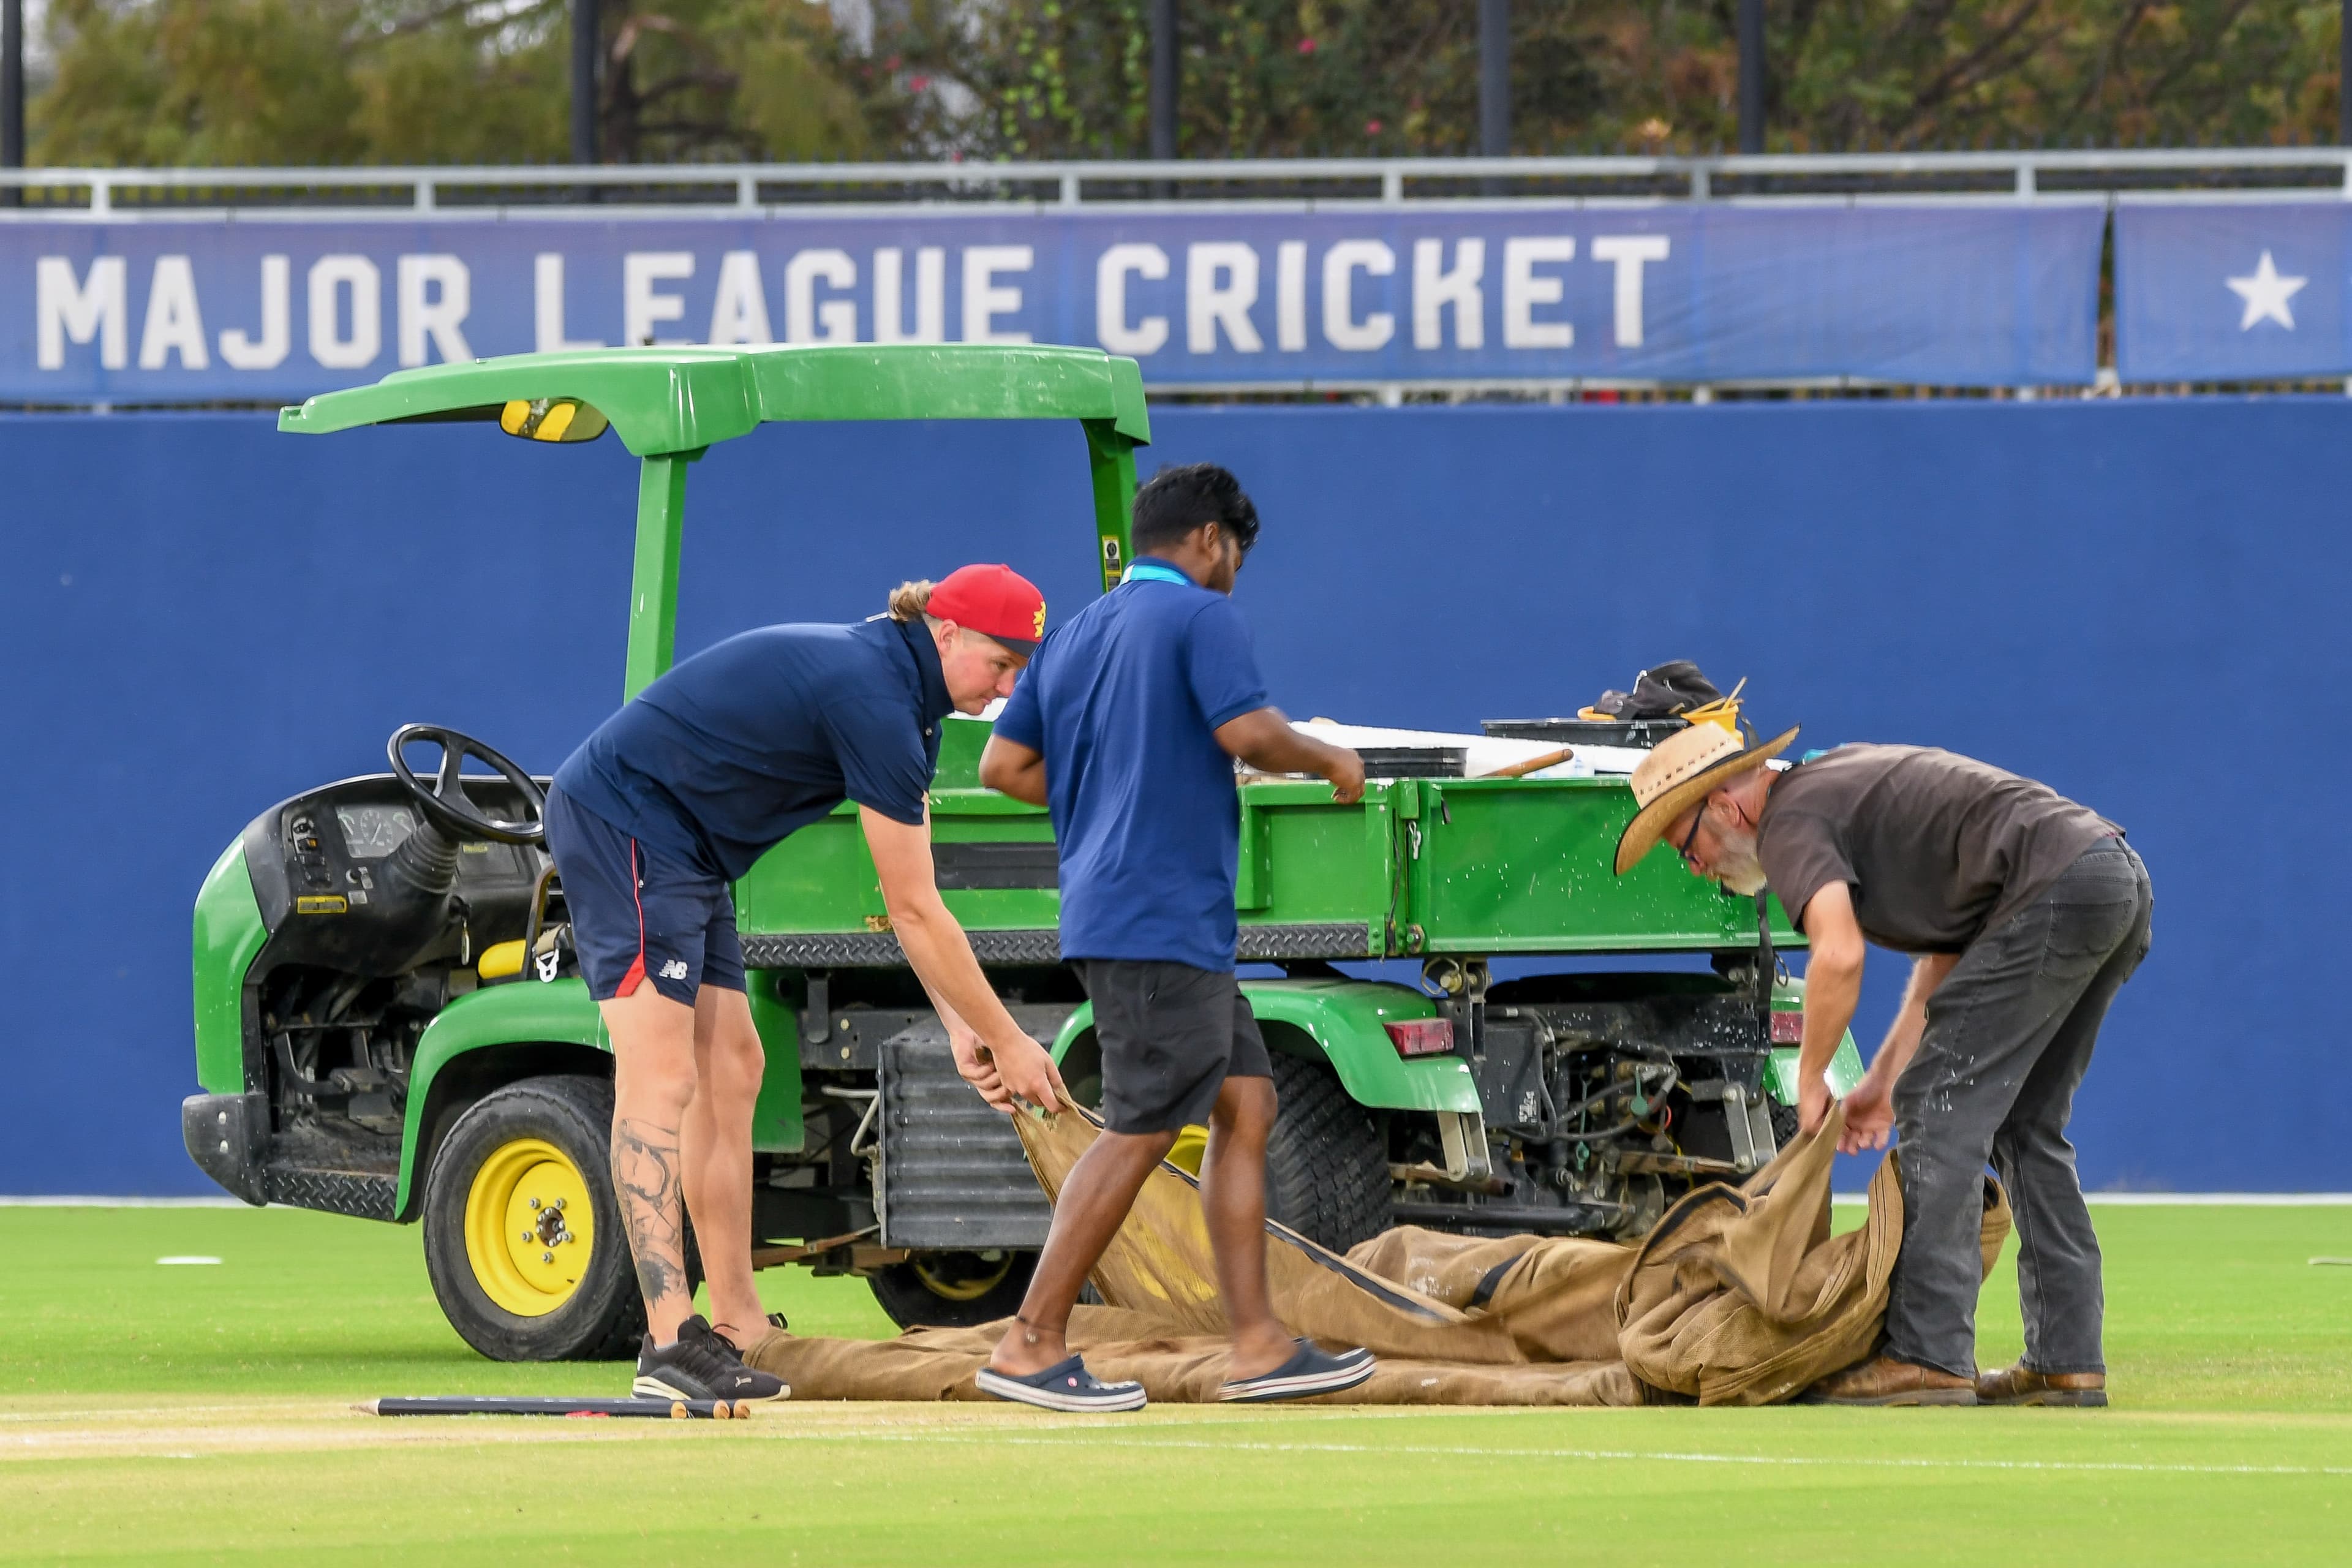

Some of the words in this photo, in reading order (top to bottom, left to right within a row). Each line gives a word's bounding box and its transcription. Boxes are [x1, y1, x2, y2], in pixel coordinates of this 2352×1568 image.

[36, 253, 475, 369] MAJOR
[535, 248, 1034, 349] LEAGUE
[1097, 236, 1670, 356] CRICKET
